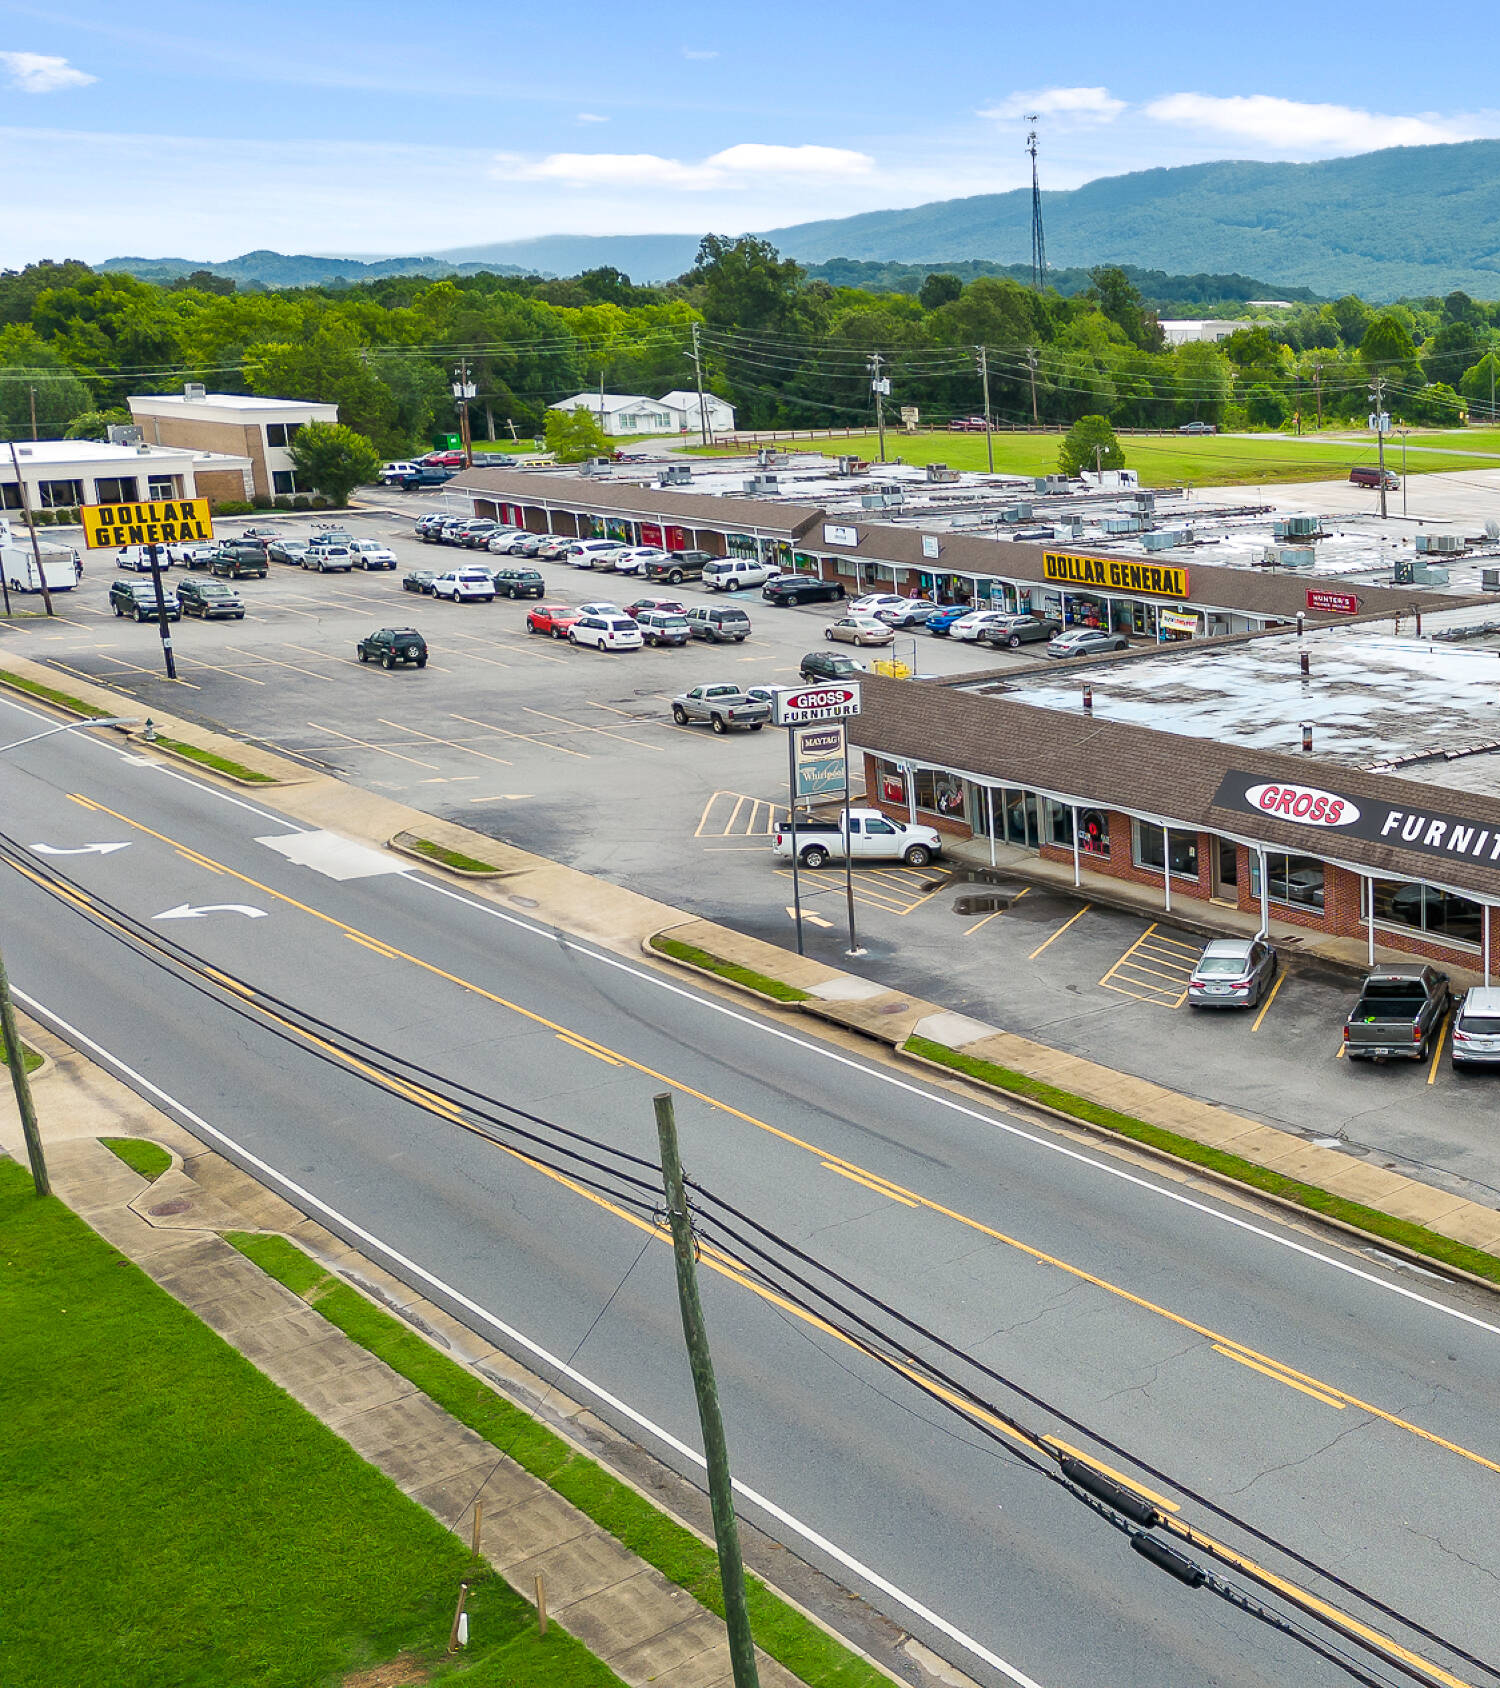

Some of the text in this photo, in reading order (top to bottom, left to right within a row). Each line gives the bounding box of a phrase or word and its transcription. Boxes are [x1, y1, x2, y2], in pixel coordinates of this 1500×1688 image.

[98, 502, 196, 526] DOLLAR
[95, 522, 208, 546] GENERAL
[1046, 554, 1183, 594] DOLLAR GENERAL
[797, 691, 845, 708] GROSS
[783, 705, 859, 722] FURNITURE
[805, 736, 837, 747] MAYTAG
[800, 762, 845, 788] Whirlpool
[1258, 786, 1345, 824] GROSS
